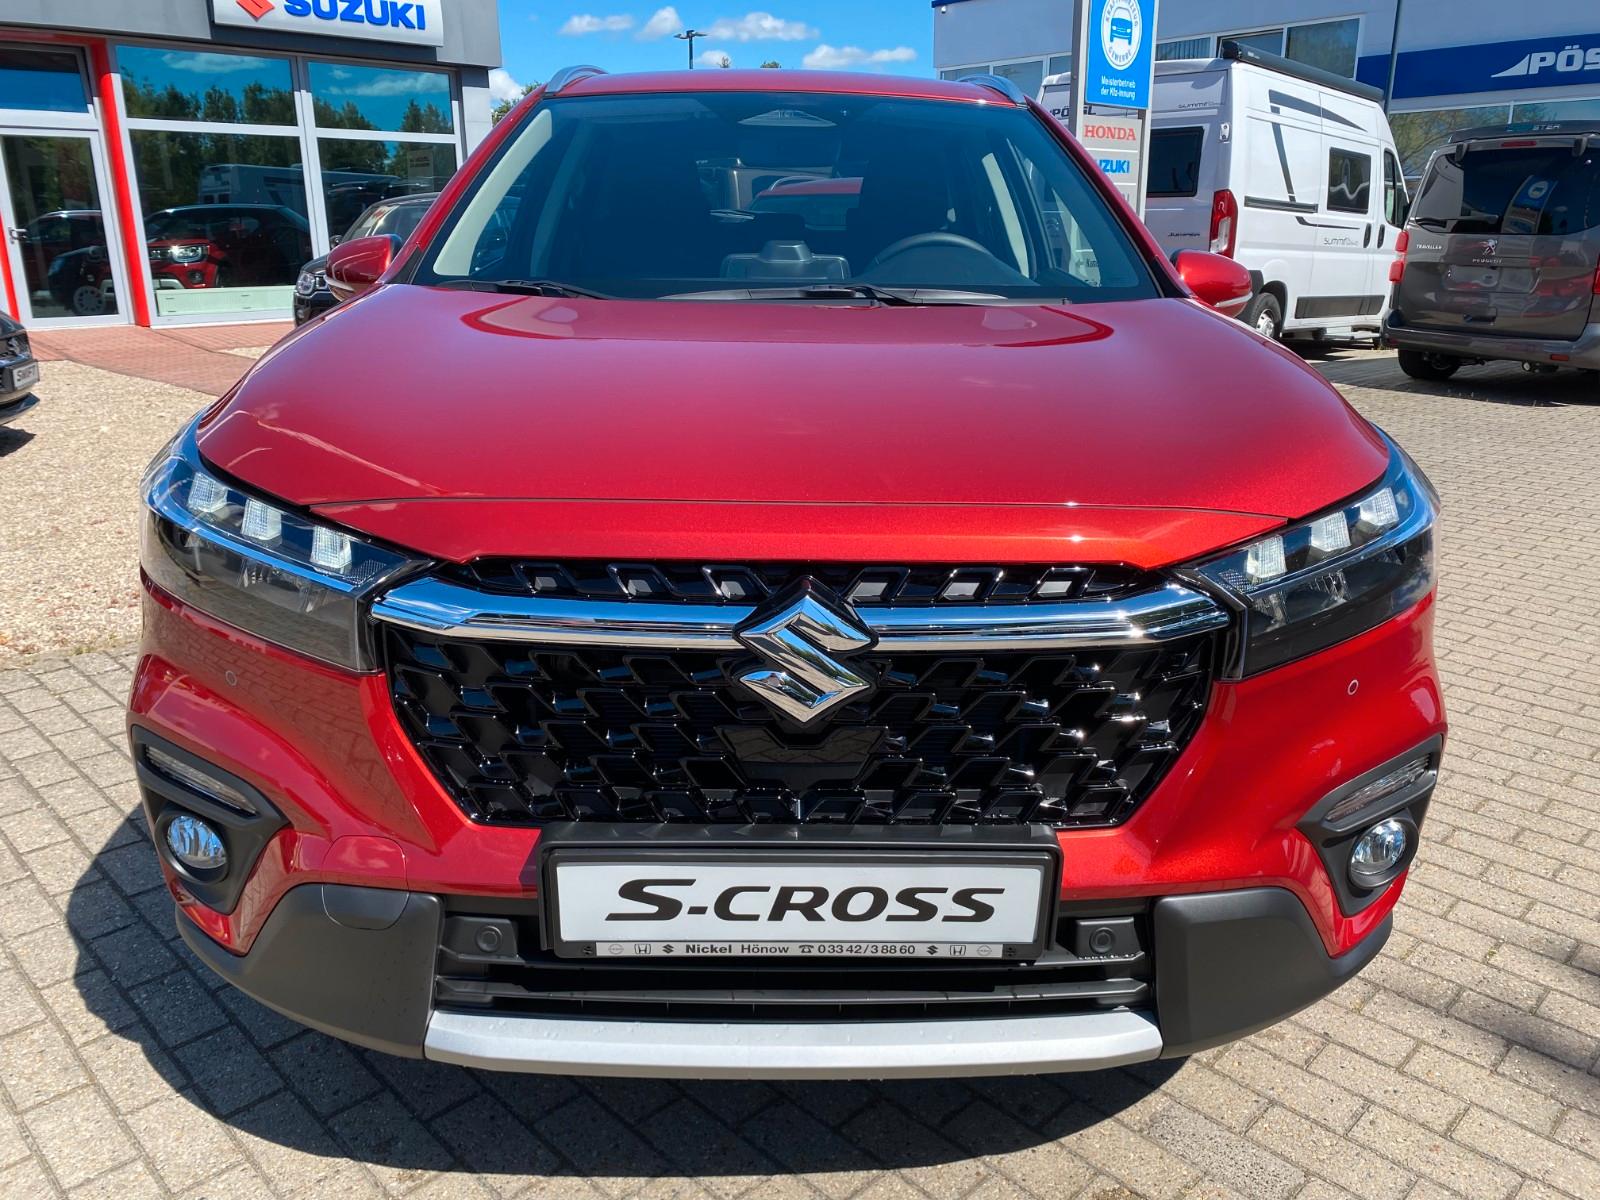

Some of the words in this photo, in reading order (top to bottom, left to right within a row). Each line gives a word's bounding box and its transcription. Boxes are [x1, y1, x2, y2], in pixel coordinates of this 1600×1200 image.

[284, 0, 426, 30] SUZUKI
[1100, 86, 1109, 96] der
[1084, 125, 1136, 141] HONDA
[604, 877, 1005, 923] S-CROSS
[685, 944, 732, 954] Nickel
[740, 944, 789, 954] Hönow
